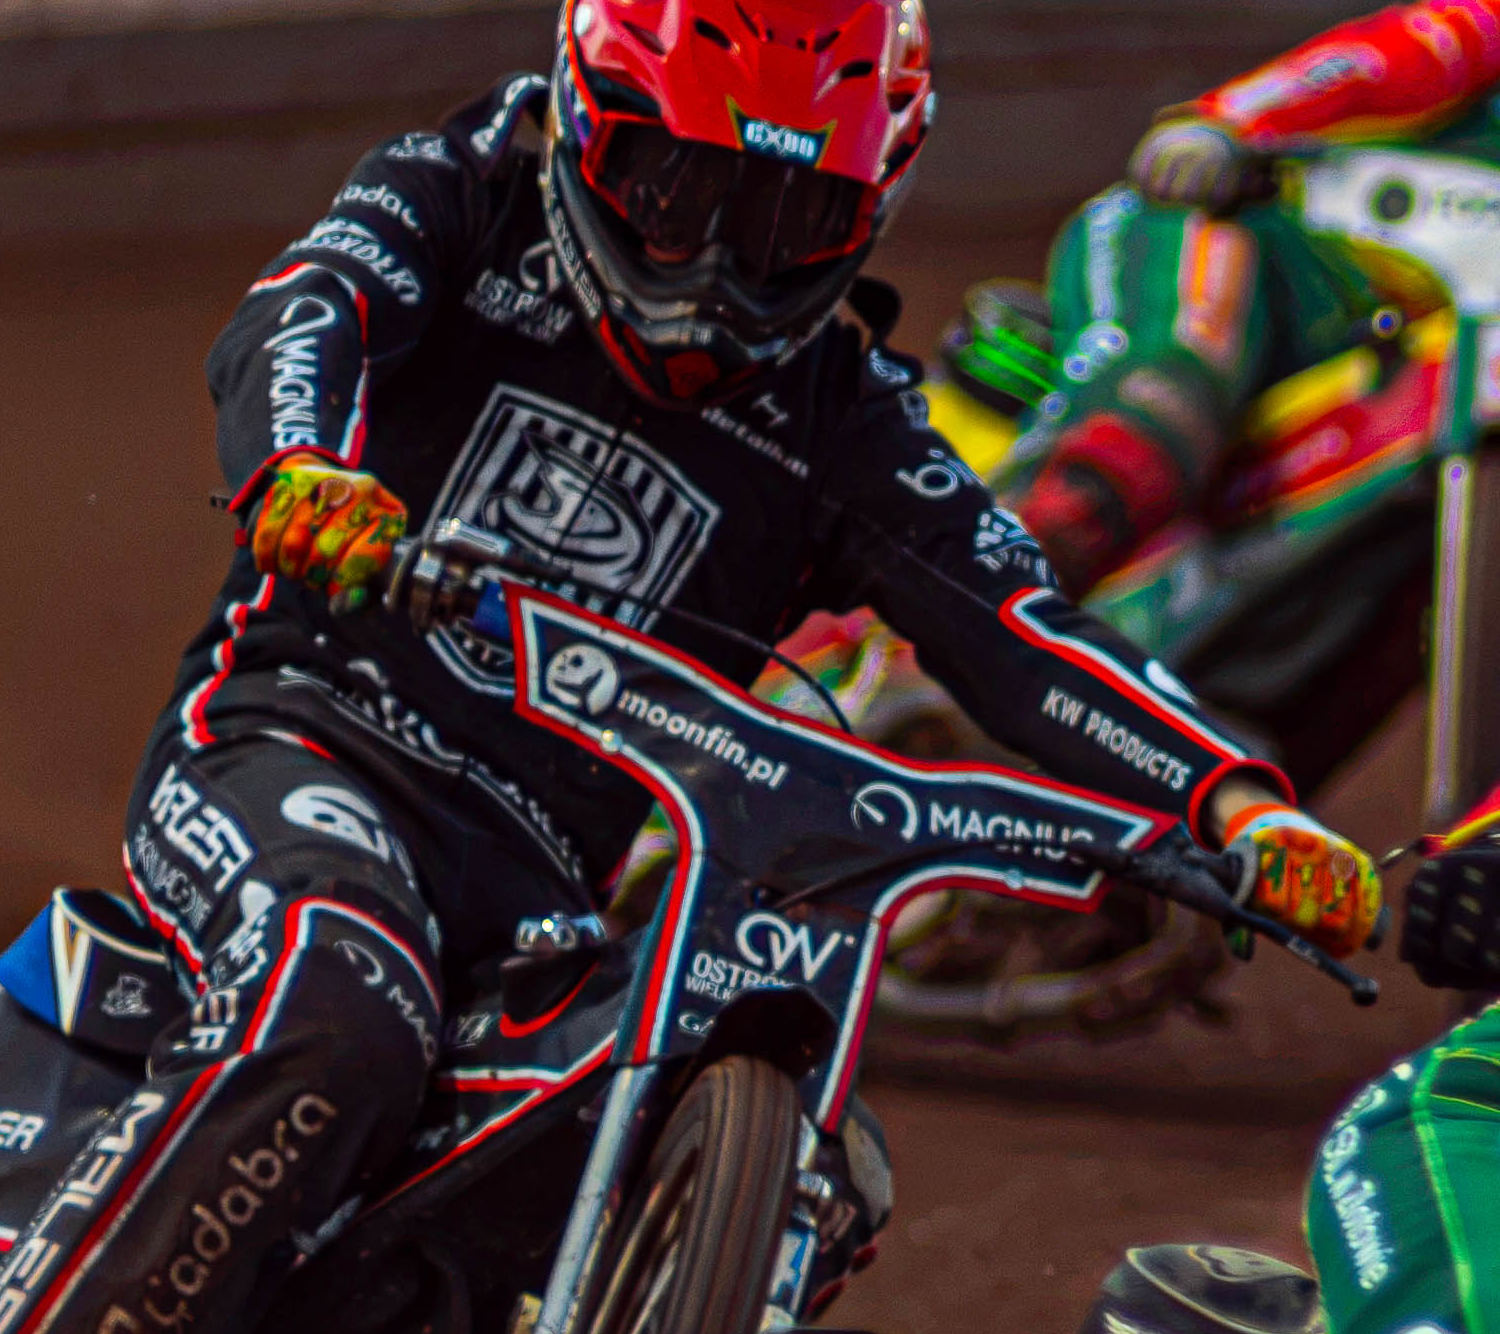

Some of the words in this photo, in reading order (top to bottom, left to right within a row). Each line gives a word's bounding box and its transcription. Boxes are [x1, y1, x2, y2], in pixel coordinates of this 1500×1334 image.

[268, 336, 319, 451] MAGNUS
[616, 687, 789, 790] moonfin.pl
[1041, 684, 1086, 727] KW
[1082, 706, 1193, 792] PRODUCTS
